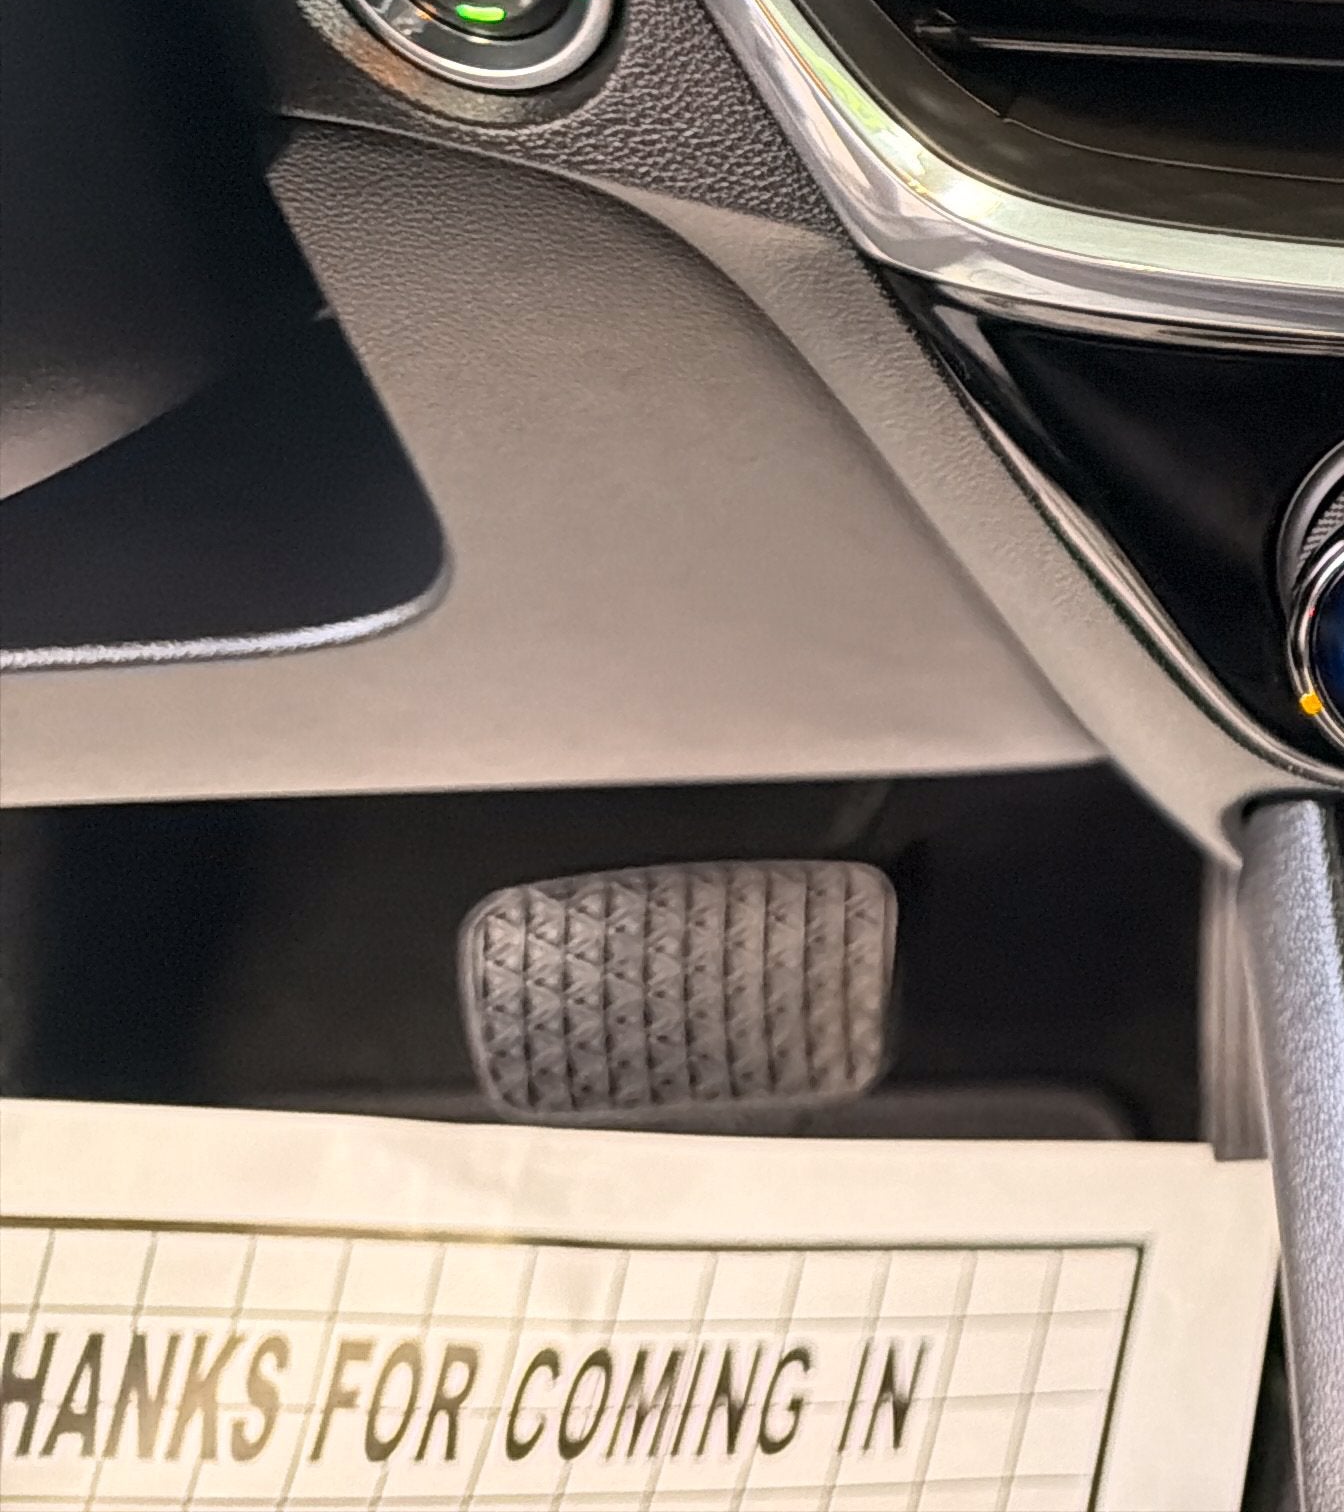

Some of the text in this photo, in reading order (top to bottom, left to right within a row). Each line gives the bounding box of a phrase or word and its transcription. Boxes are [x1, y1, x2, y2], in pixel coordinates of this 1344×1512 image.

[309, 1337, 481, 1461] FOR
[505, 1343, 815, 1457] COMING
[836, 1337, 932, 1454] IN
